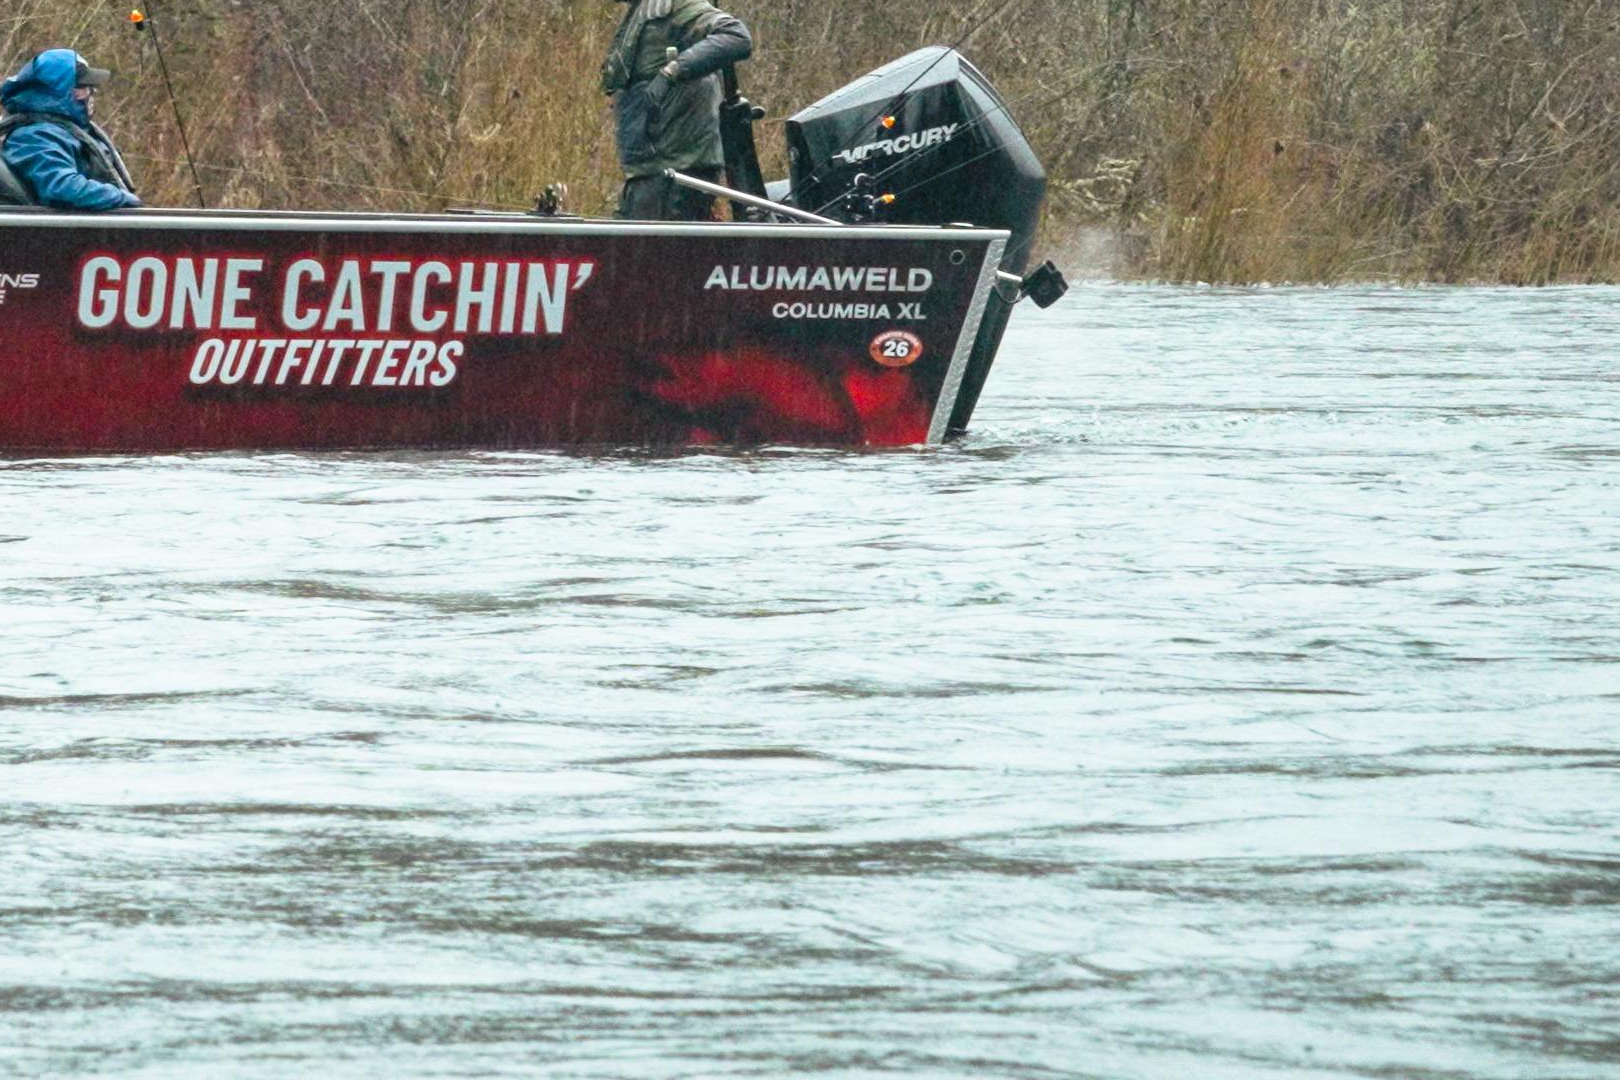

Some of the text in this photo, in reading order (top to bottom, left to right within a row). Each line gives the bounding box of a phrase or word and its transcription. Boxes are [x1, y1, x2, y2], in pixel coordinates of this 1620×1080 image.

[703, 265, 933, 292] ALUMAWELD
[79, 256, 594, 334] GONE CATCHIN'
[772, 302, 927, 320] COLUMBIA XL
[883, 340, 909, 357] 26
[189, 338, 463, 387] OUTFITTERS
